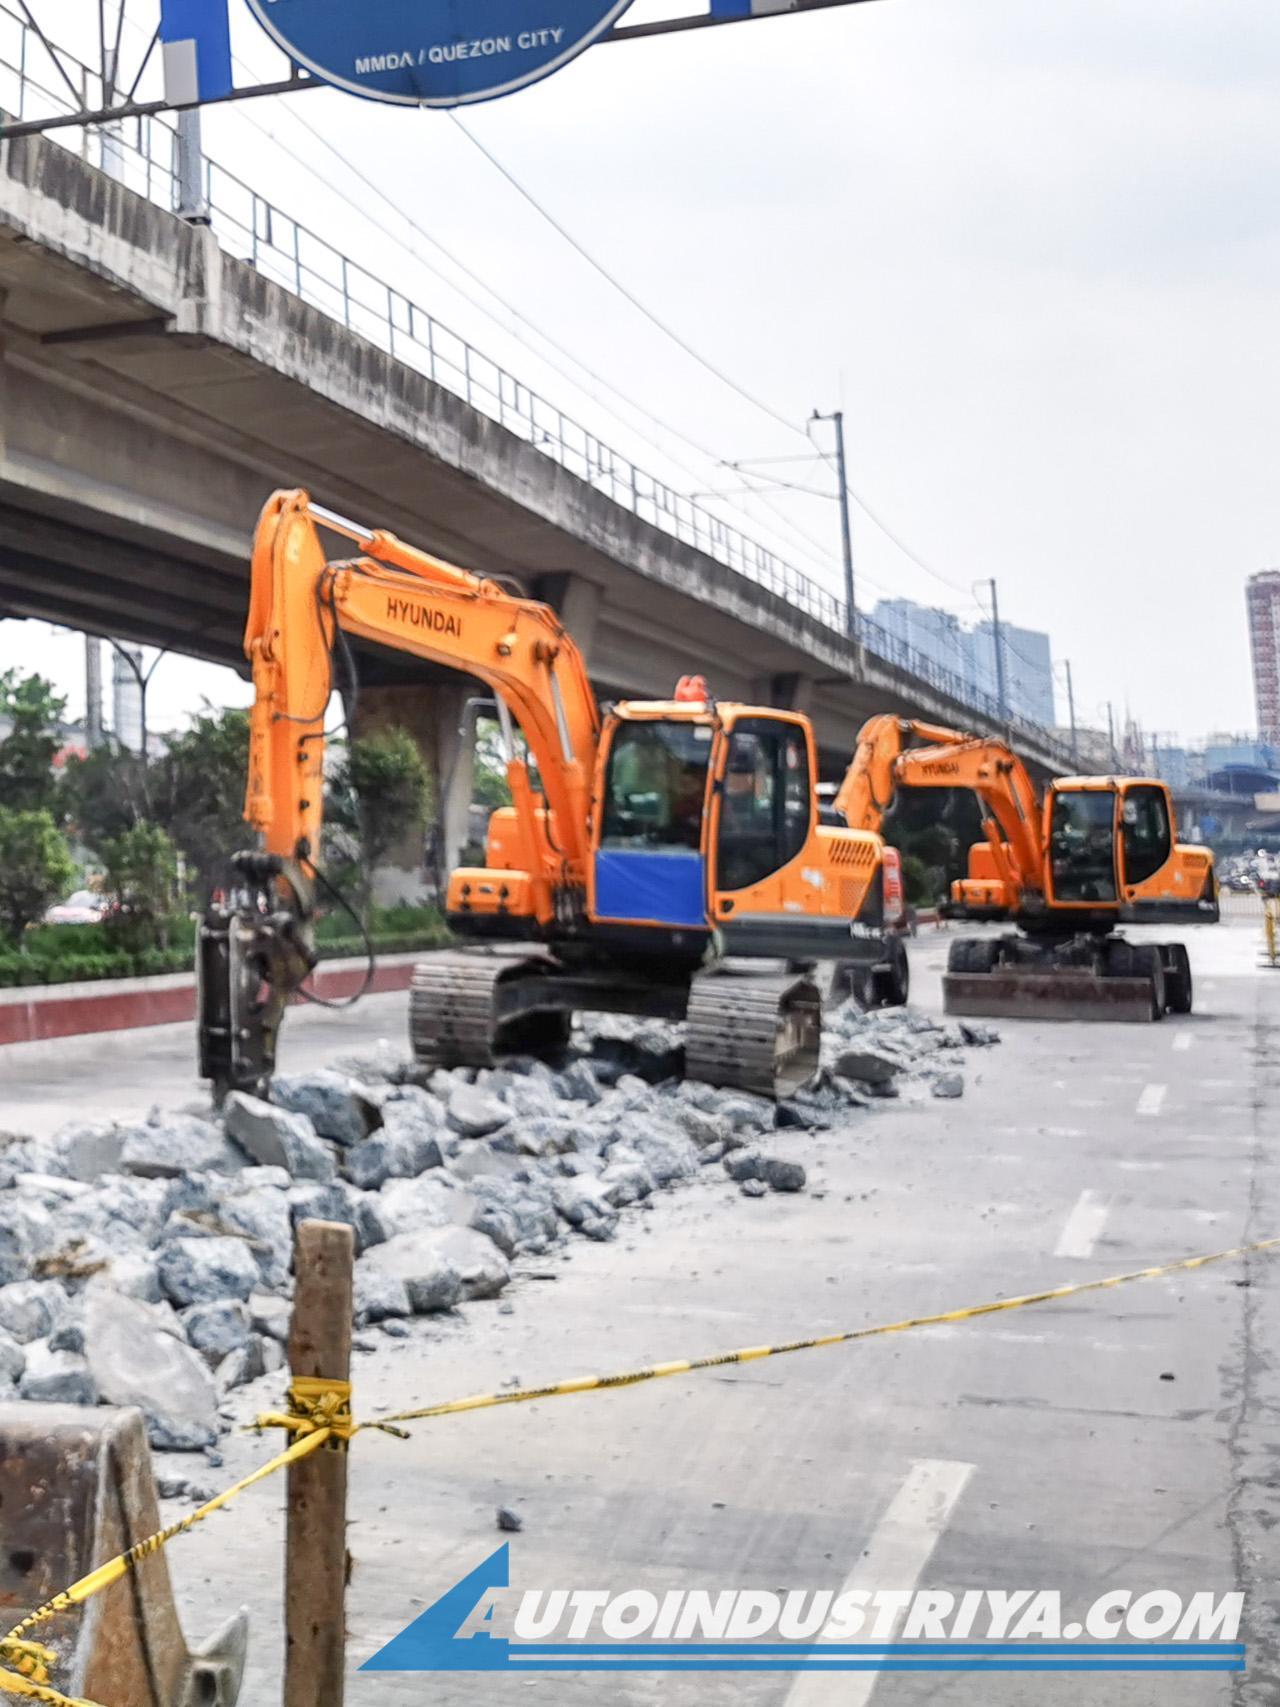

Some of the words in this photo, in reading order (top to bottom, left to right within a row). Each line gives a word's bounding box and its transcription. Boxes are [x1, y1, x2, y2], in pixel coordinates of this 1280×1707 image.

[355, 52, 414, 74] MMDA
[428, 36, 512, 64] QUEZON
[517, 27, 565, 50] CITY
[386, 597, 461, 637] HYUNDAI
